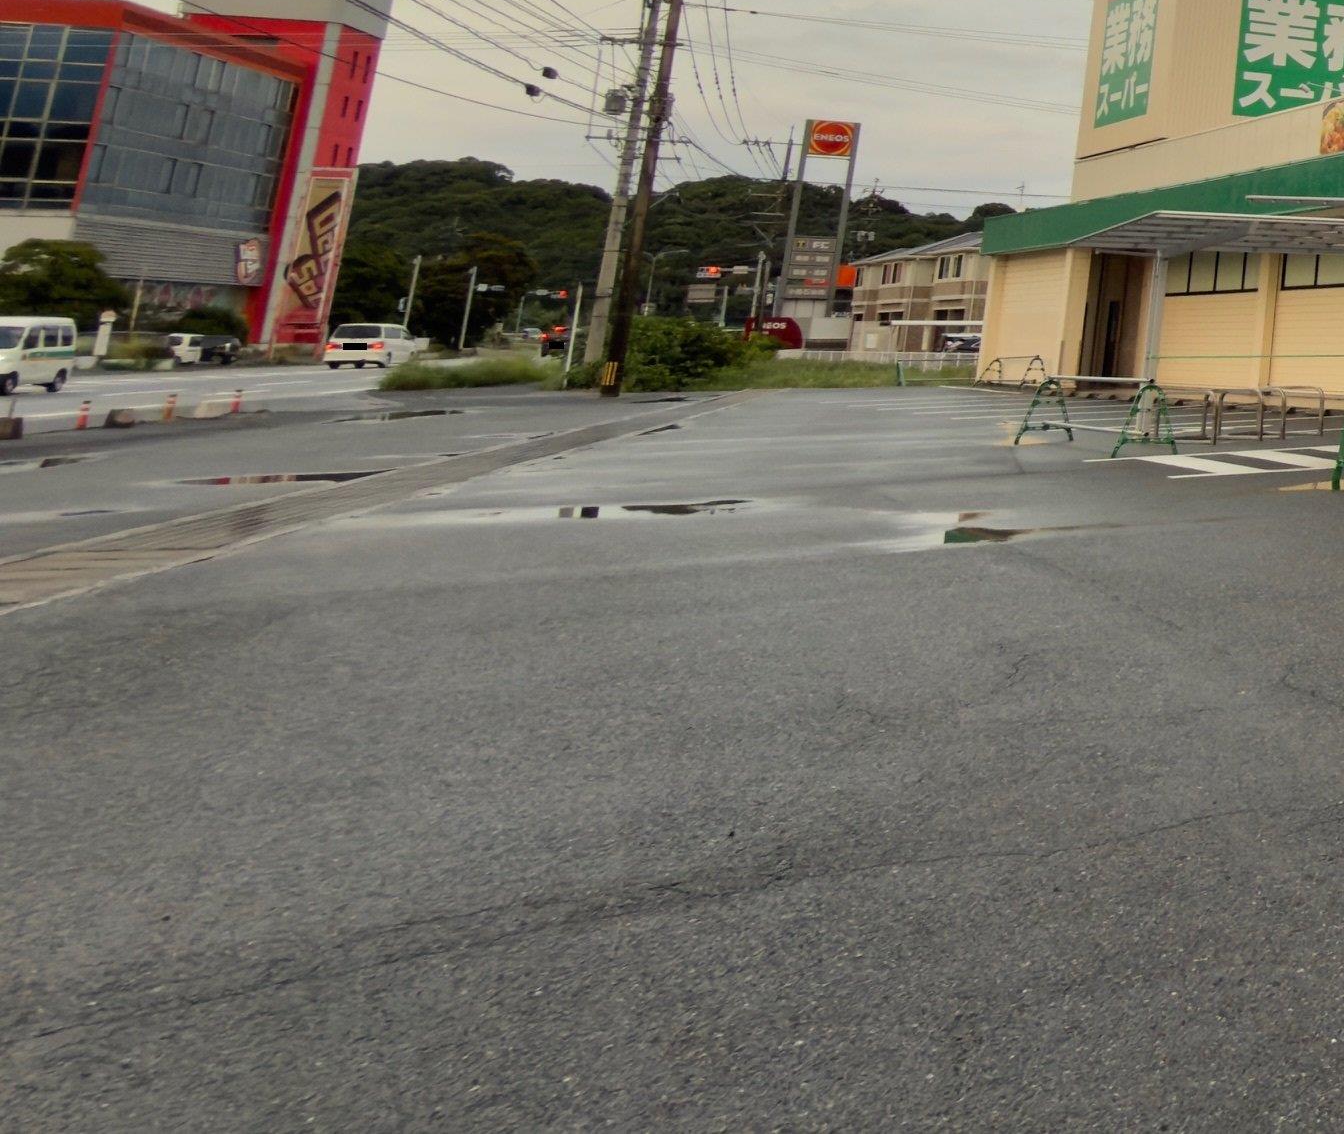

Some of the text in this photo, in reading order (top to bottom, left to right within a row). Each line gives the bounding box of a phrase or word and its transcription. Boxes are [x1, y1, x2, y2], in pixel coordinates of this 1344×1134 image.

[1097, 71, 1149, 118] スーパー
[813, 133, 849, 143] ENEOS
